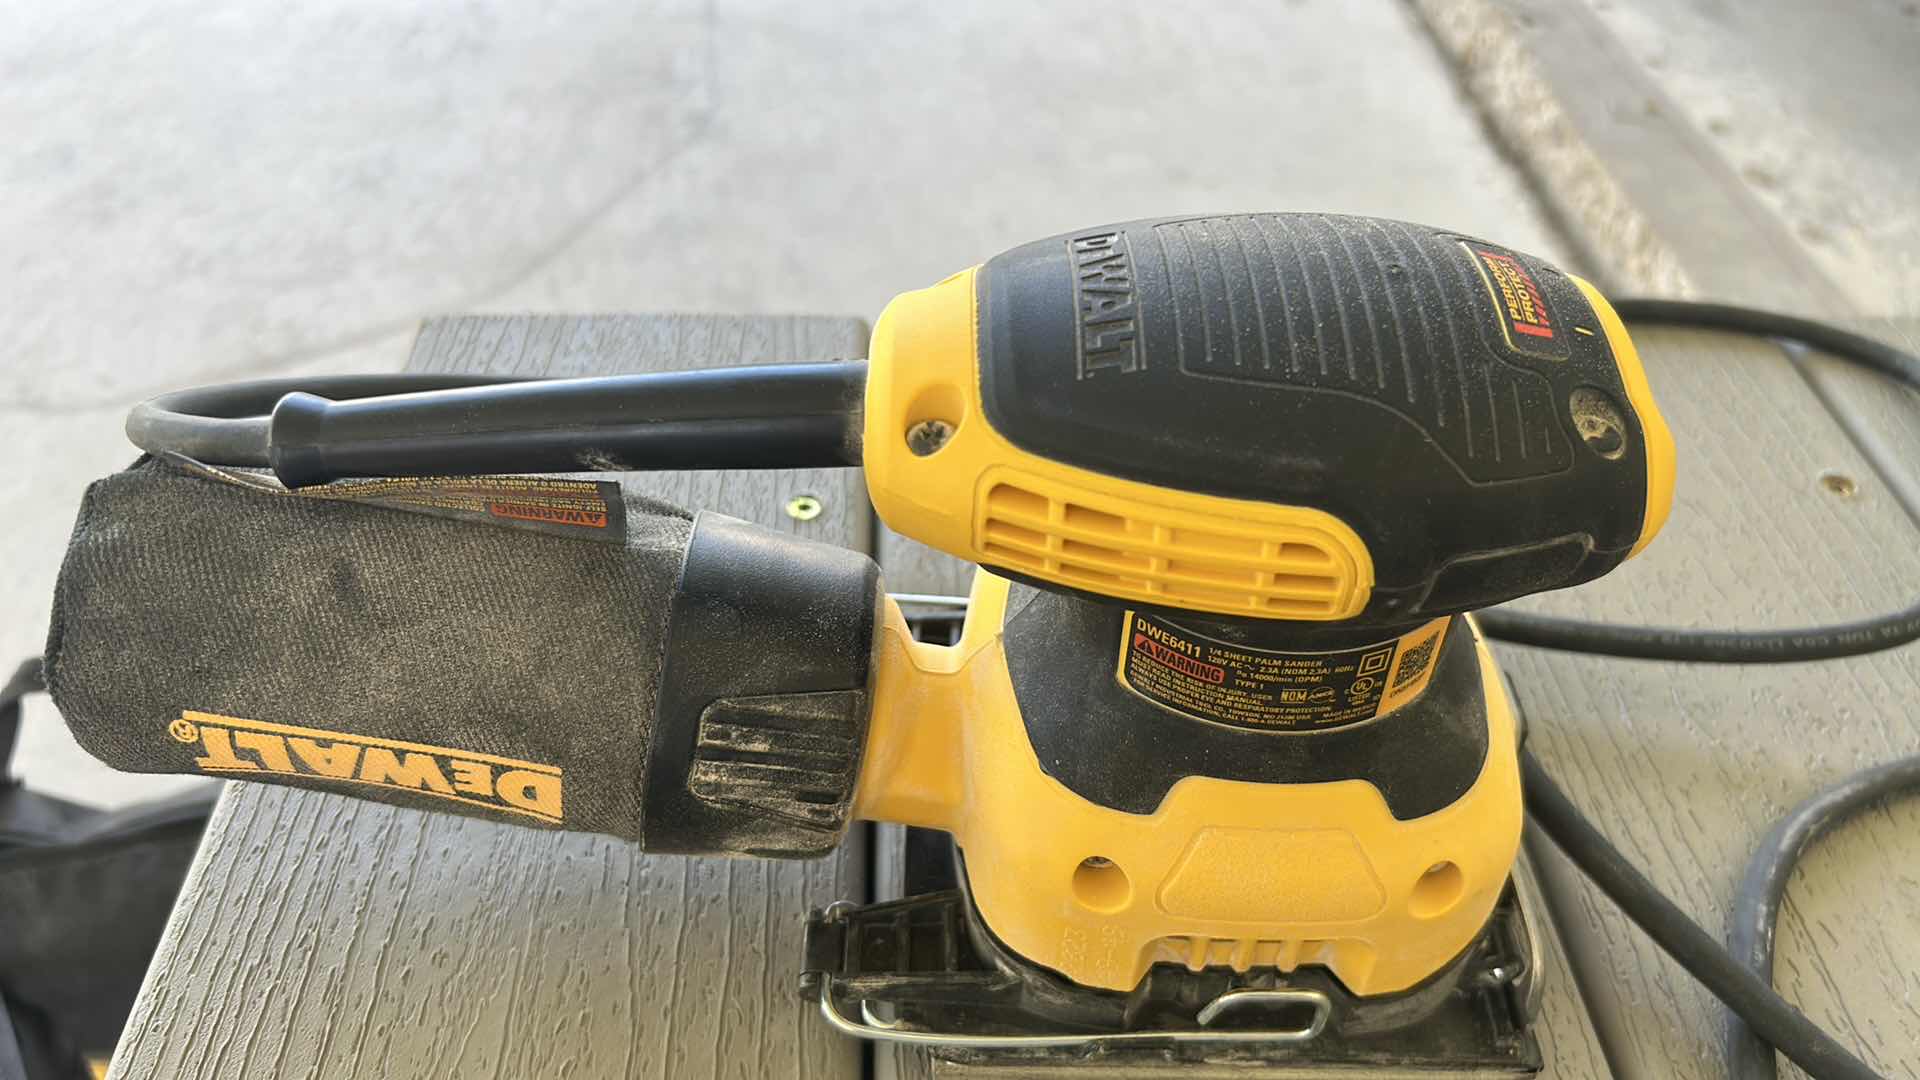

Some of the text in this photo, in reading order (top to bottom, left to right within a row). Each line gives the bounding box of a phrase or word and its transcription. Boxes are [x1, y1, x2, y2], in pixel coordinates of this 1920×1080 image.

[1482, 256, 1521, 321] PERFORM
[1498, 260, 1538, 324] PROTECT
[495, 504, 583, 522] WARNING
[1137, 618, 1201, 658] DWE6411
[1153, 645, 1221, 681] WARNING
[1223, 651, 1253, 663] SHEET
[1254, 657, 1282, 667] PALM
[1284, 660, 1322, 668] SANDER
[1173, 676, 1225, 698] INSTRUCTION
[1235, 679, 1257, 689] TYPE
[1281, 690, 1308, 702] NOM
[195, 722, 563, 819] DEWALT
